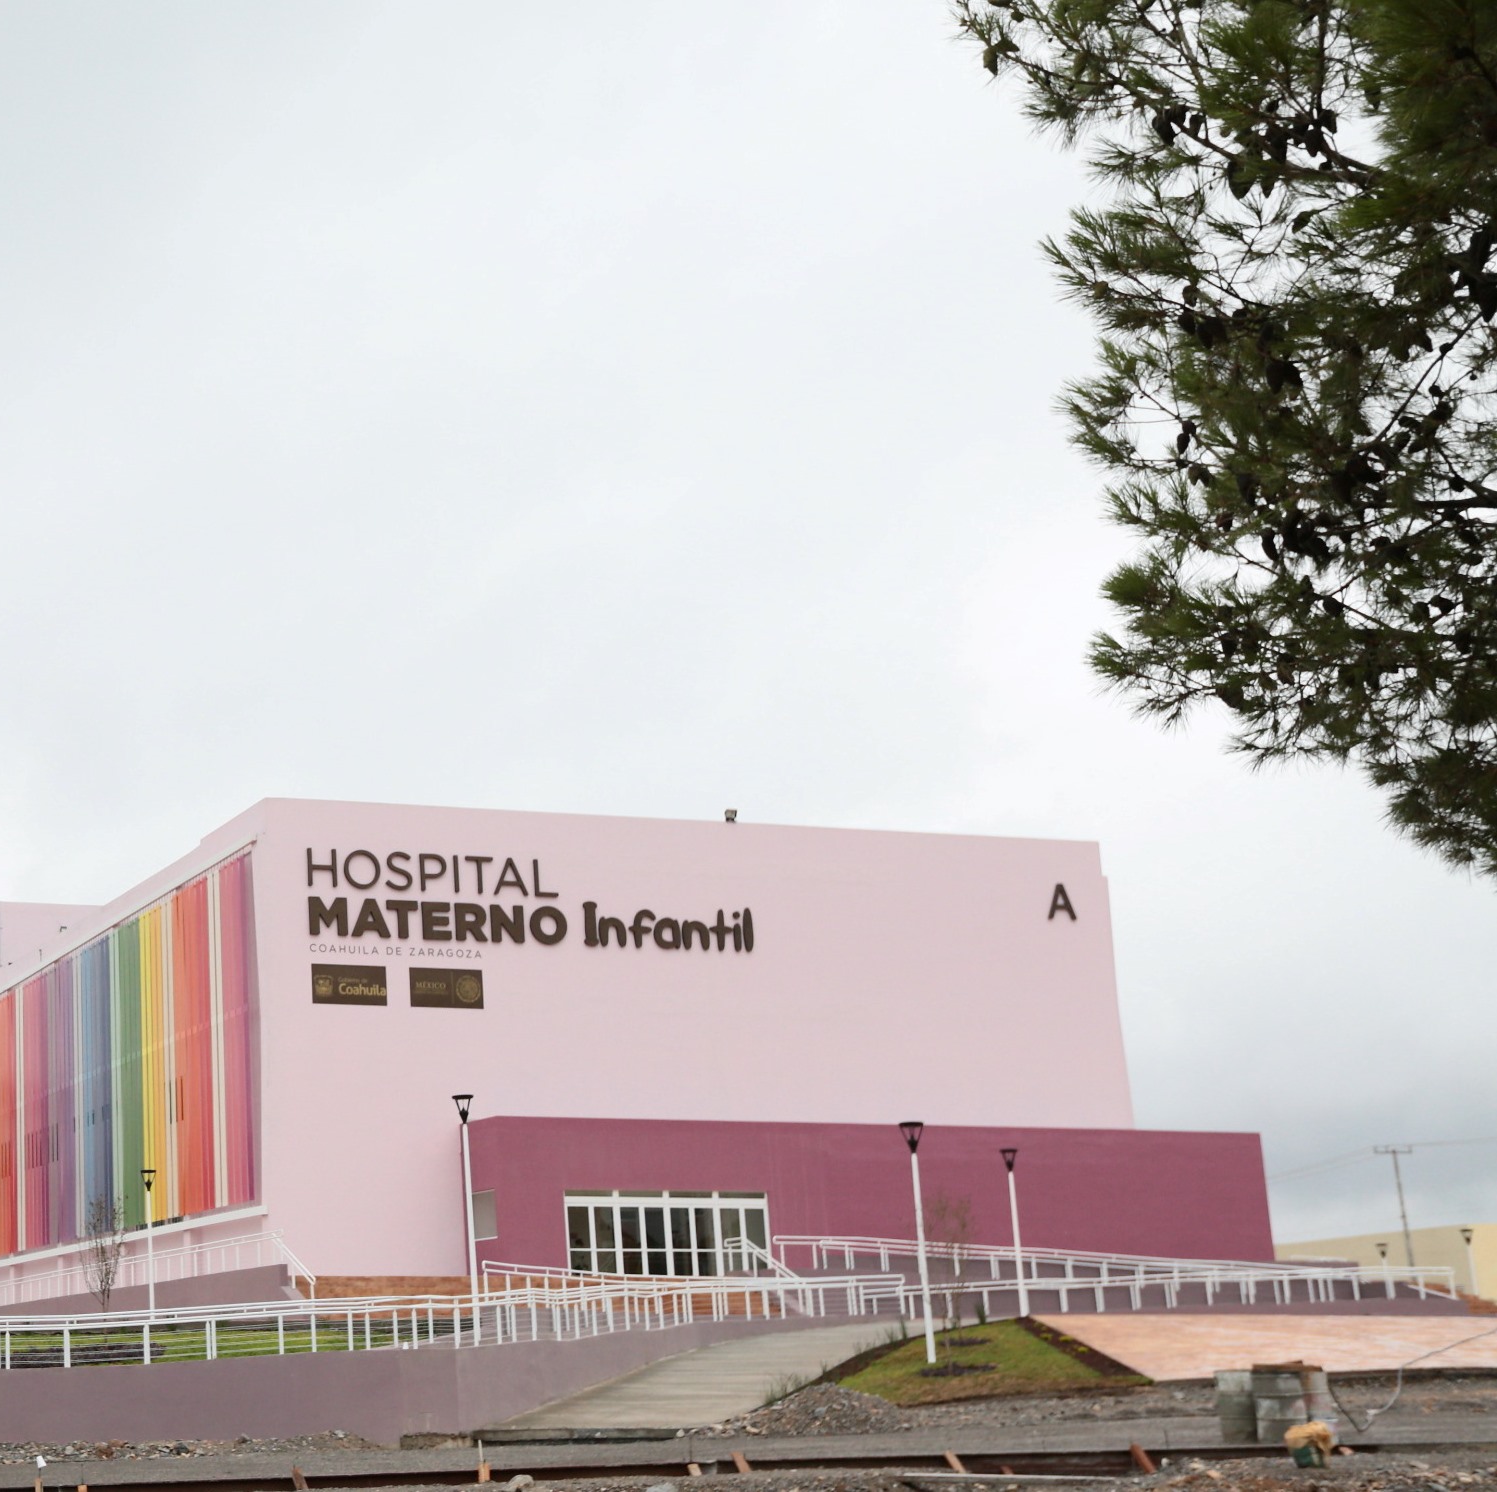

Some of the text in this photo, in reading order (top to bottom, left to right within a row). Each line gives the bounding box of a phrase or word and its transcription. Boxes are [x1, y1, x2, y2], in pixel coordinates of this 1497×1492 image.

[307, 848, 559, 898] HOSPITAL
[1048, 883, 1077, 921] A
[308, 896, 754, 953] MATERNO Infantil
[309, 943, 482, 959] COAHUILA DE ZARAGOZA
[338, 982, 387, 996] Coahuila
